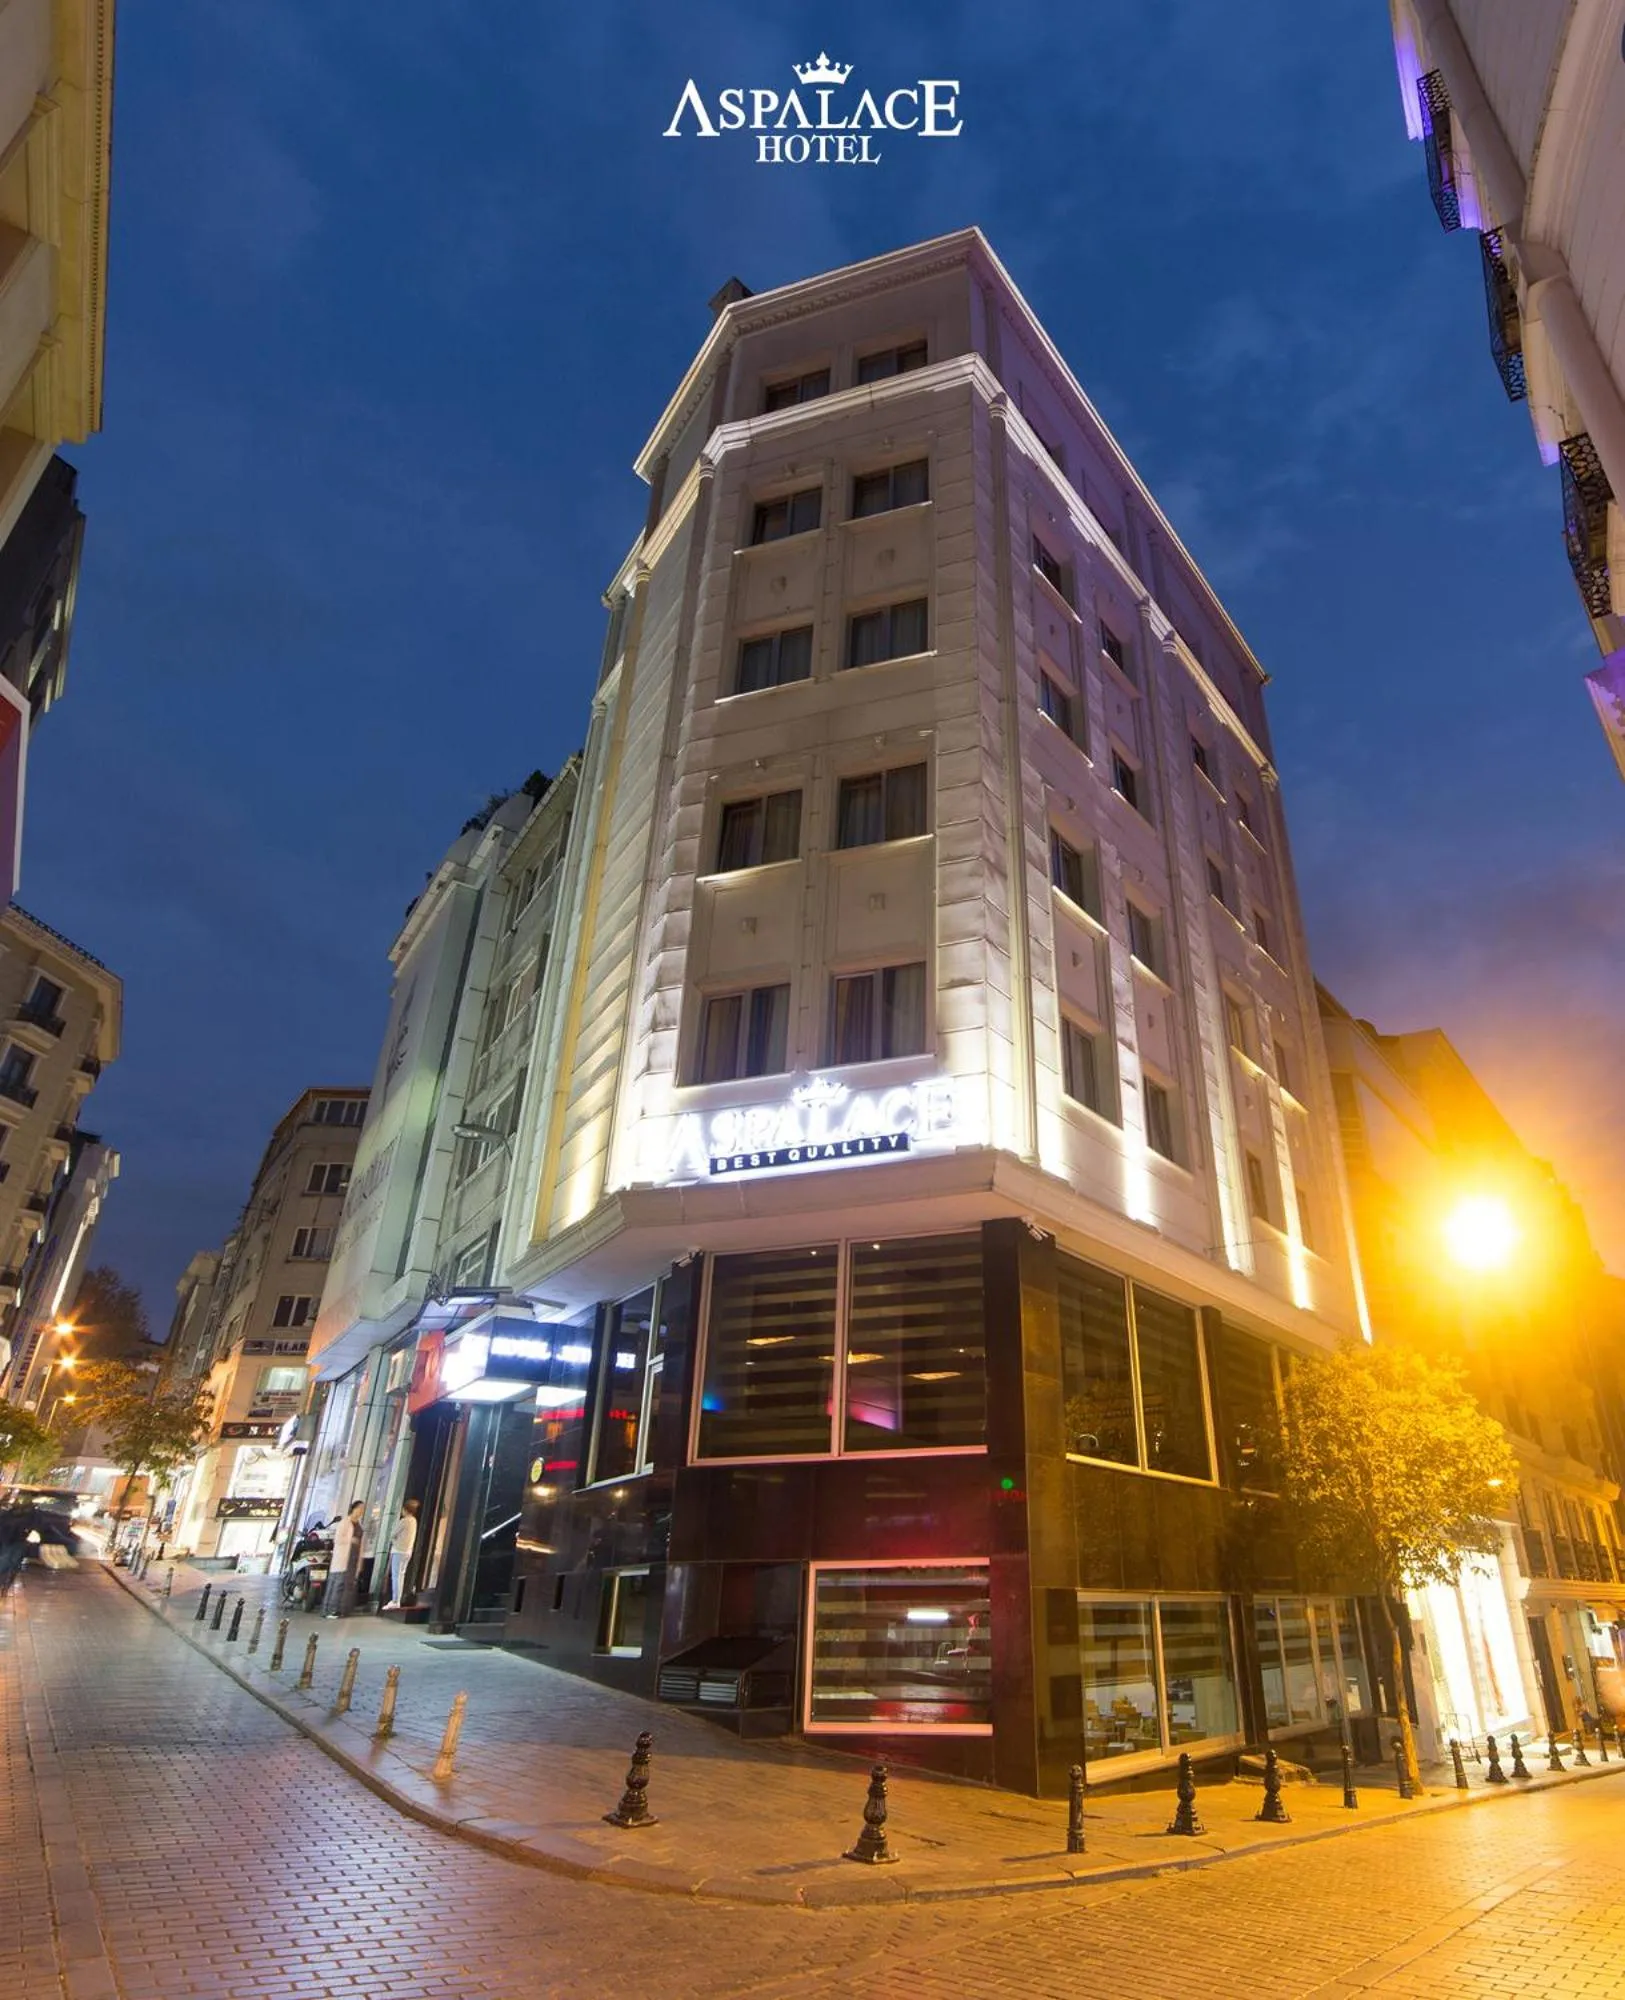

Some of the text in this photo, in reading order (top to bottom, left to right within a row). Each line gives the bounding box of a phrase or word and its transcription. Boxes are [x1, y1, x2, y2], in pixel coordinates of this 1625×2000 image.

[664, 1079, 957, 1176] ASPALACE
[716, 1134, 900, 1172] BEST QUALITY
